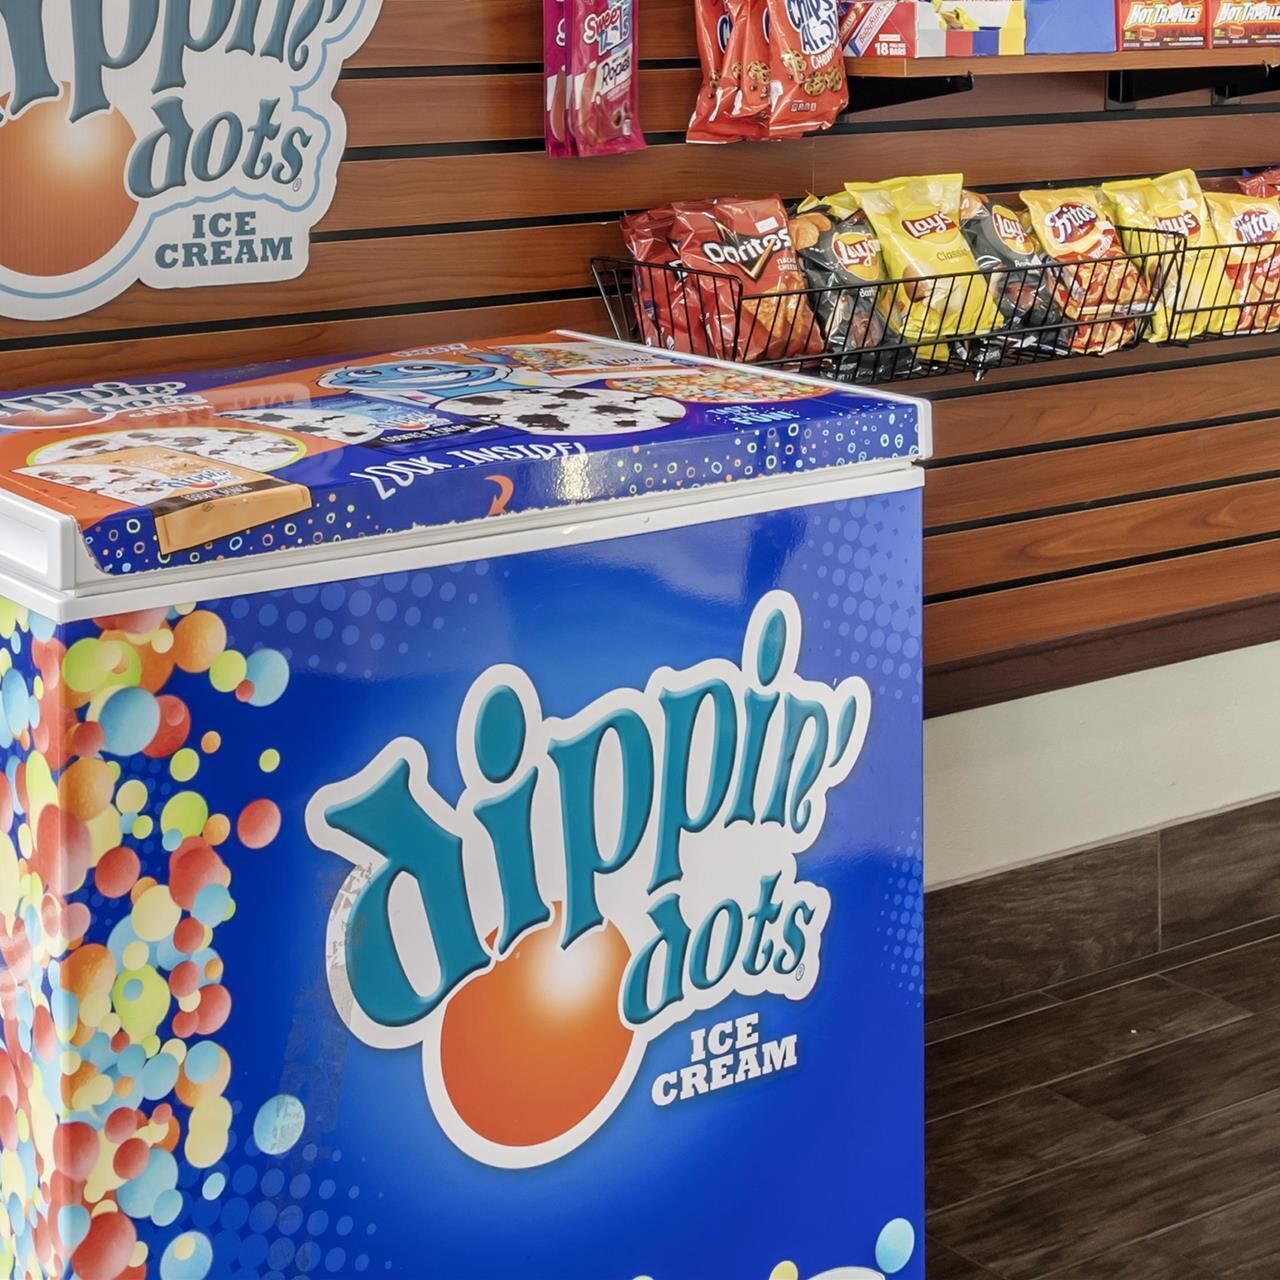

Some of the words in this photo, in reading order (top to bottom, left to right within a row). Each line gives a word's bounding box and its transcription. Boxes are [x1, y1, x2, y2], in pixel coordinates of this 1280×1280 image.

[1128, 3, 1154, 23] HOT
[1217, 2, 1242, 22] HOT
[874, 42, 889, 56] 18
[889, 47, 907, 56] BARS
[601, 54, 632, 88] Ropes
[127, 96, 312, 199] dots
[191, 211, 257, 239] ICE
[904, 209, 954, 239] Lay's
[1044, 202, 1098, 244] Fritos
[1235, 208, 1280, 244] Fritos
[154, 237, 293, 270] CREAM
[703, 227, 791, 265] Doritos
[350, 456, 453, 501] LOOK
[623, 870, 816, 1024] dots
[690, 1012, 761, 1063] ICE
[651, 1034, 798, 1106] CREAM
